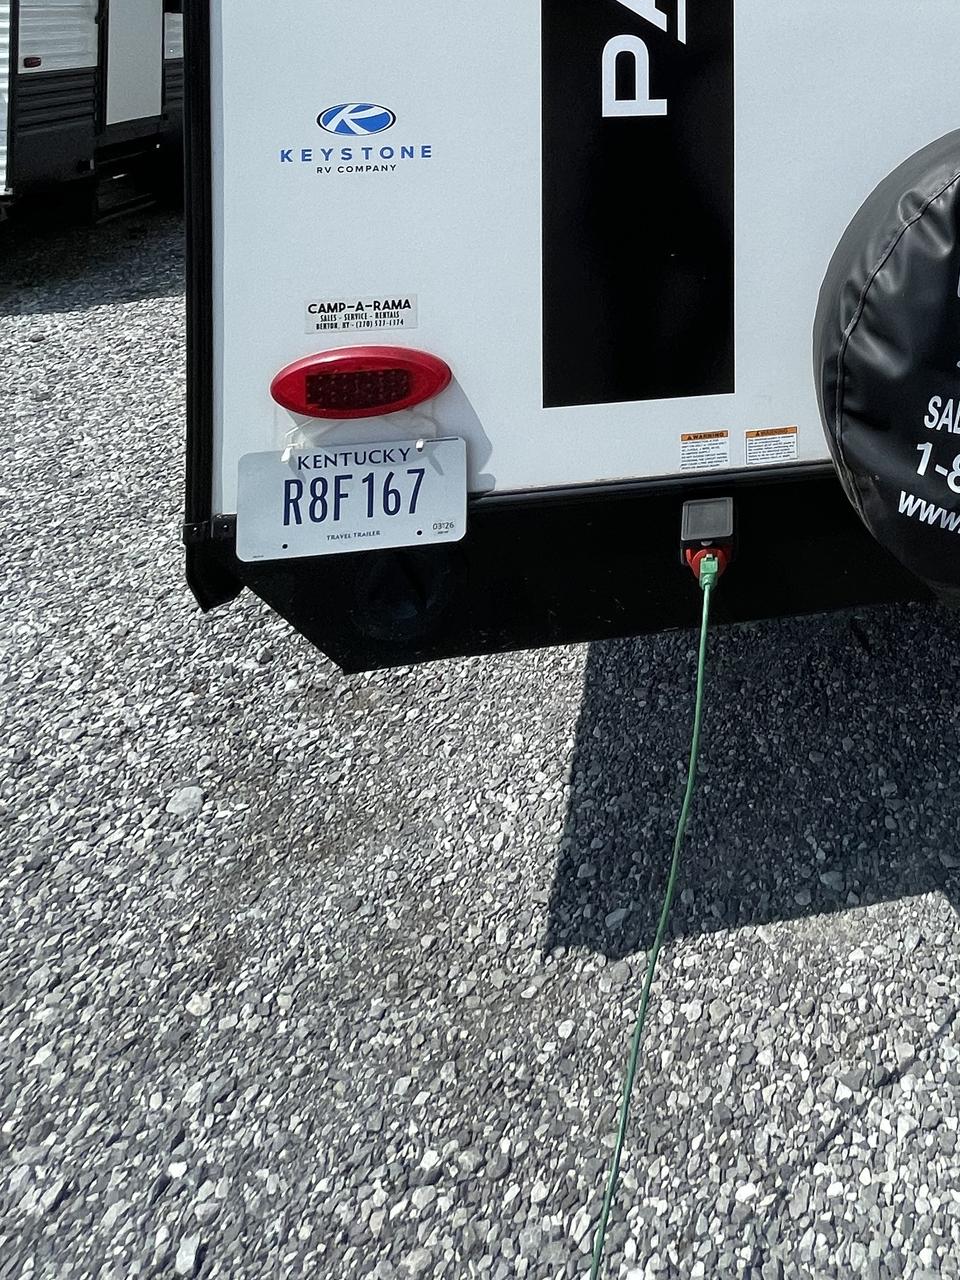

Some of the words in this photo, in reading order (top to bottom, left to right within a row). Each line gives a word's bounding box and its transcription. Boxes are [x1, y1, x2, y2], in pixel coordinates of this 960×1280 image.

[280, 145, 432, 163] KEYSTONE
[316, 166, 332, 174] RV
[337, 164, 397, 174] COMPANY
[307, 299, 412, 314] CAMP-A-RAMA
[320, 314, 337, 323] SALES
[344, 312, 368, 321] SERVICE
[375, 311, 400, 319] RENTALS
[297, 448, 411, 470] KENTUCKY
[353, 530, 381, 538] TRAILER
